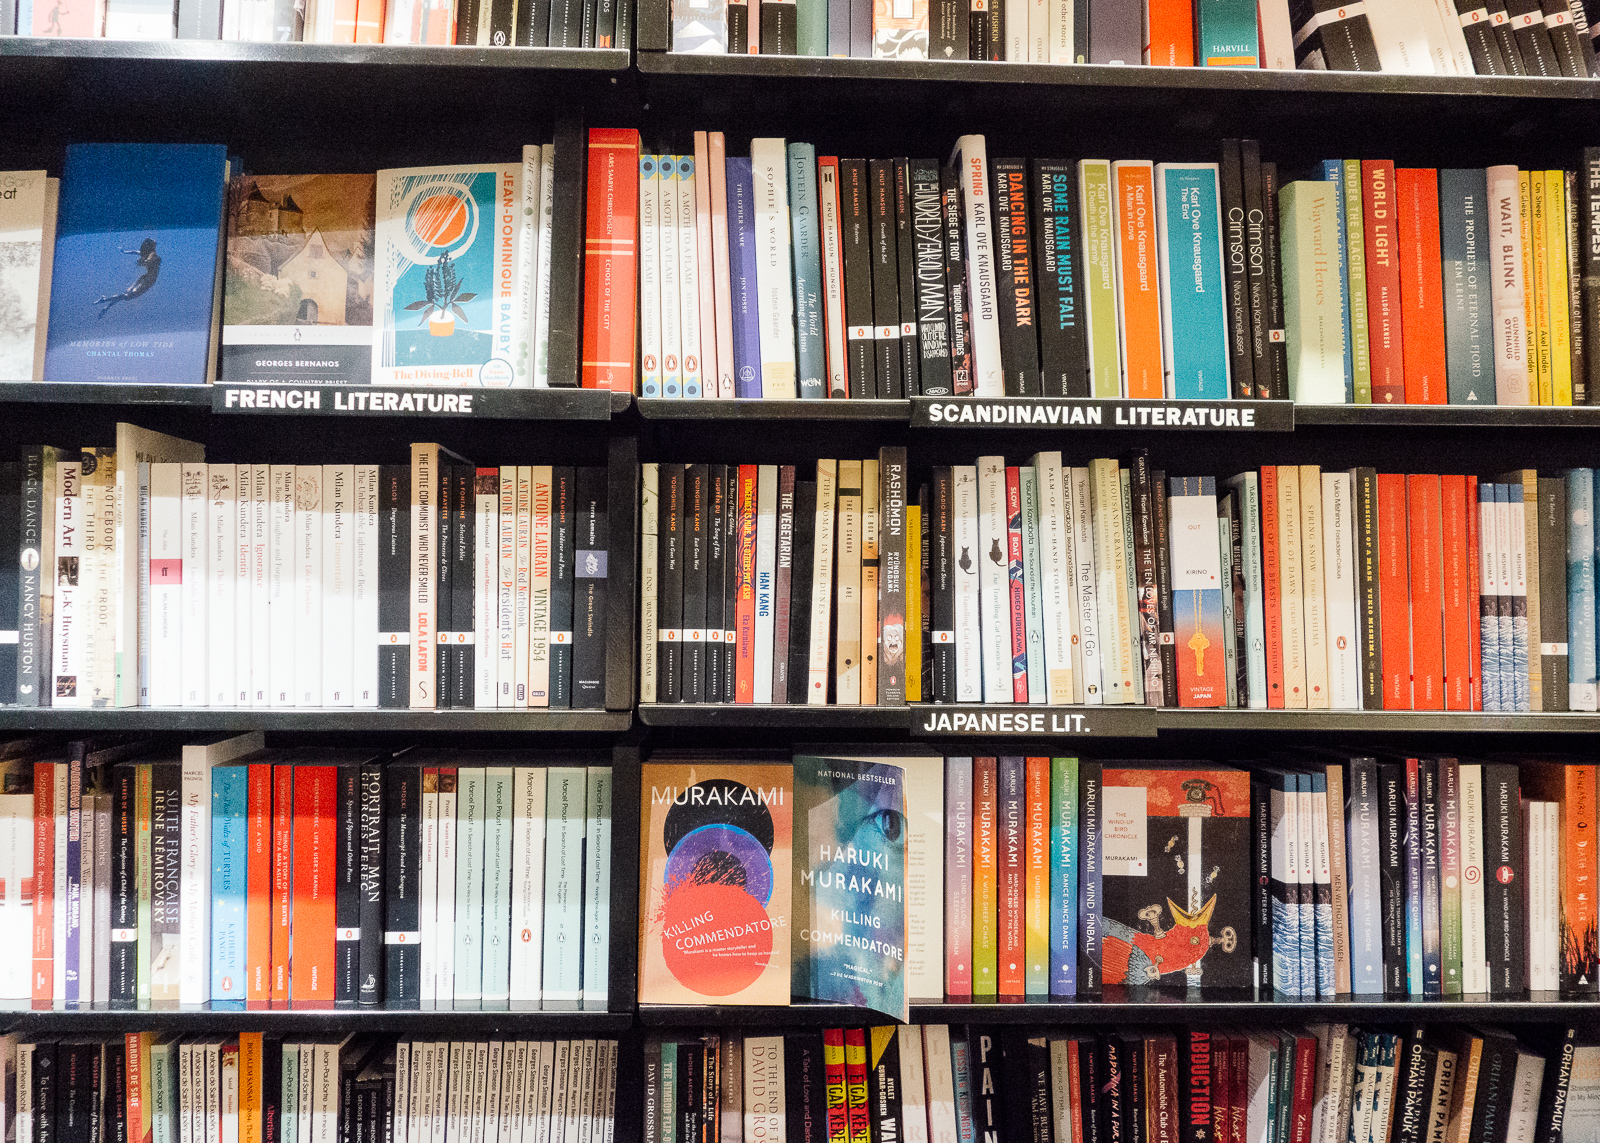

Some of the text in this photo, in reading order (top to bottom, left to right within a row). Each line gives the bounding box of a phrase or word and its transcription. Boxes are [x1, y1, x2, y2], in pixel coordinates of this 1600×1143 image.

[1213, 44, 1250, 52] HARVILL
[1009, 173, 1026, 235] DANCING
[1053, 174, 1067, 212] SOME
[1181, 187, 1190, 219] The End
[947, 188, 960, 261] THE SIEGE OF TROY
[1055, 216, 1070, 250] RAIN
[1373, 168, 1389, 267] WORLD LIGHT
[768, 227, 777, 267] WORLD
[971, 158, 993, 320] SPRING KARL OVE KNAUSGAARD
[1013, 239, 1026, 254] IN
[1190, 187, 1205, 293] Karl Ove Knausgaard
[1248, 209, 1264, 276] Crimson
[1311, 196, 1328, 305] Wayward Heroes
[1500, 197, 1515, 289] WAIT, BLINK
[500, 171, 514, 354] JEAN-DOMINIQUE BAUBY
[1013, 258, 1028, 284] THE
[1056, 254, 1073, 293] MUST
[604, 288, 611, 297] OF
[920, 283, 944, 321] MAN
[1454, 260, 1464, 312] KIM LEINE
[1464, 195, 1481, 378] THE PROPHETS OF ETERNAL FJORD
[1015, 288, 1032, 327] DARK
[1060, 297, 1075, 329] FALL
[70, 340, 174, 348] MEMORIES of LOW TIDE
[1504, 318, 1513, 360] ØYEHAUG
[1512, 316, 1520, 361] GUNNHILD
[255, 359, 339, 368] GEORGES BERNANOS
[393, 368, 473, 380] The Diving-Bell
[225, 389, 473, 413] FRENCH LITERATURE
[929, 403, 1255, 427] SCANDINAVIAN LITERATURE
[26, 454, 38, 544] BLACK DANCE
[890, 464, 903, 536] RASHŌMON
[1010, 486, 1018, 508] SLOW
[254, 469, 265, 588] Milan Kundera Ignorance
[418, 453, 429, 604] THE LITTLE COMMUNIST WHO NEVER SMILED
[780, 492, 793, 568] THE VEGETARIAN
[60, 467, 77, 673] Modern Art J.-K. Huysmans
[533, 482, 549, 662] ANTOINE LAURAIN VINTAGE 1954
[759, 572, 770, 617] HAN KANG
[1081, 560, 1095, 657] The Master of Go
[22, 575, 34, 674] NANCY HUSTON
[1014, 587, 1023, 653] HIDEO FURUKAWA
[418, 612, 428, 672] LOLA LAFON
[923, 713, 1091, 733] JAPANESE LIT.
[596, 780, 604, 804] Marcel
[650, 785, 784, 806] MURAKAMI
[817, 770, 896, 786] NATIONAL BESTSELLER
[98, 813, 108, 866] Cockroaches
[360, 772, 369, 891] GEORGES PEREC
[368, 772, 381, 902] PORTRAIT MAN
[1061, 801, 1071, 867] MURAKAMI
[154, 790, 167, 924] IRÈNE NÉMIROVSKY
[164, 789, 178, 924] SUITE FRANÇAISE
[819, 844, 889, 871] HARUKI
[1086, 780, 1096, 954] HARUKI MURAKAMI WIND PINBALL
[800, 869, 903, 903] MURAKAMI
[1062, 873, 1070, 897] DANCE
[662, 910, 714, 940] KILLING
[674, 915, 787, 951] COMMENDATORE
[830, 909, 881, 929] KILLING
[1335, 894, 1343, 930] WITHOUT
[799, 929, 903, 962] COMMENDATORE
[129, 1036, 137, 1072] MARQUIS
[542, 1064, 550, 1085] Georges
[130, 1075, 137, 1085] DE
[828, 1074, 843, 1109] ETGAR
[1158, 1053, 1168, 1129] The Automobile Club
[1190, 1031, 1210, 1125] ABDUCTION
[1402, 1044, 1422, 1132] ORHAN PAMUK
